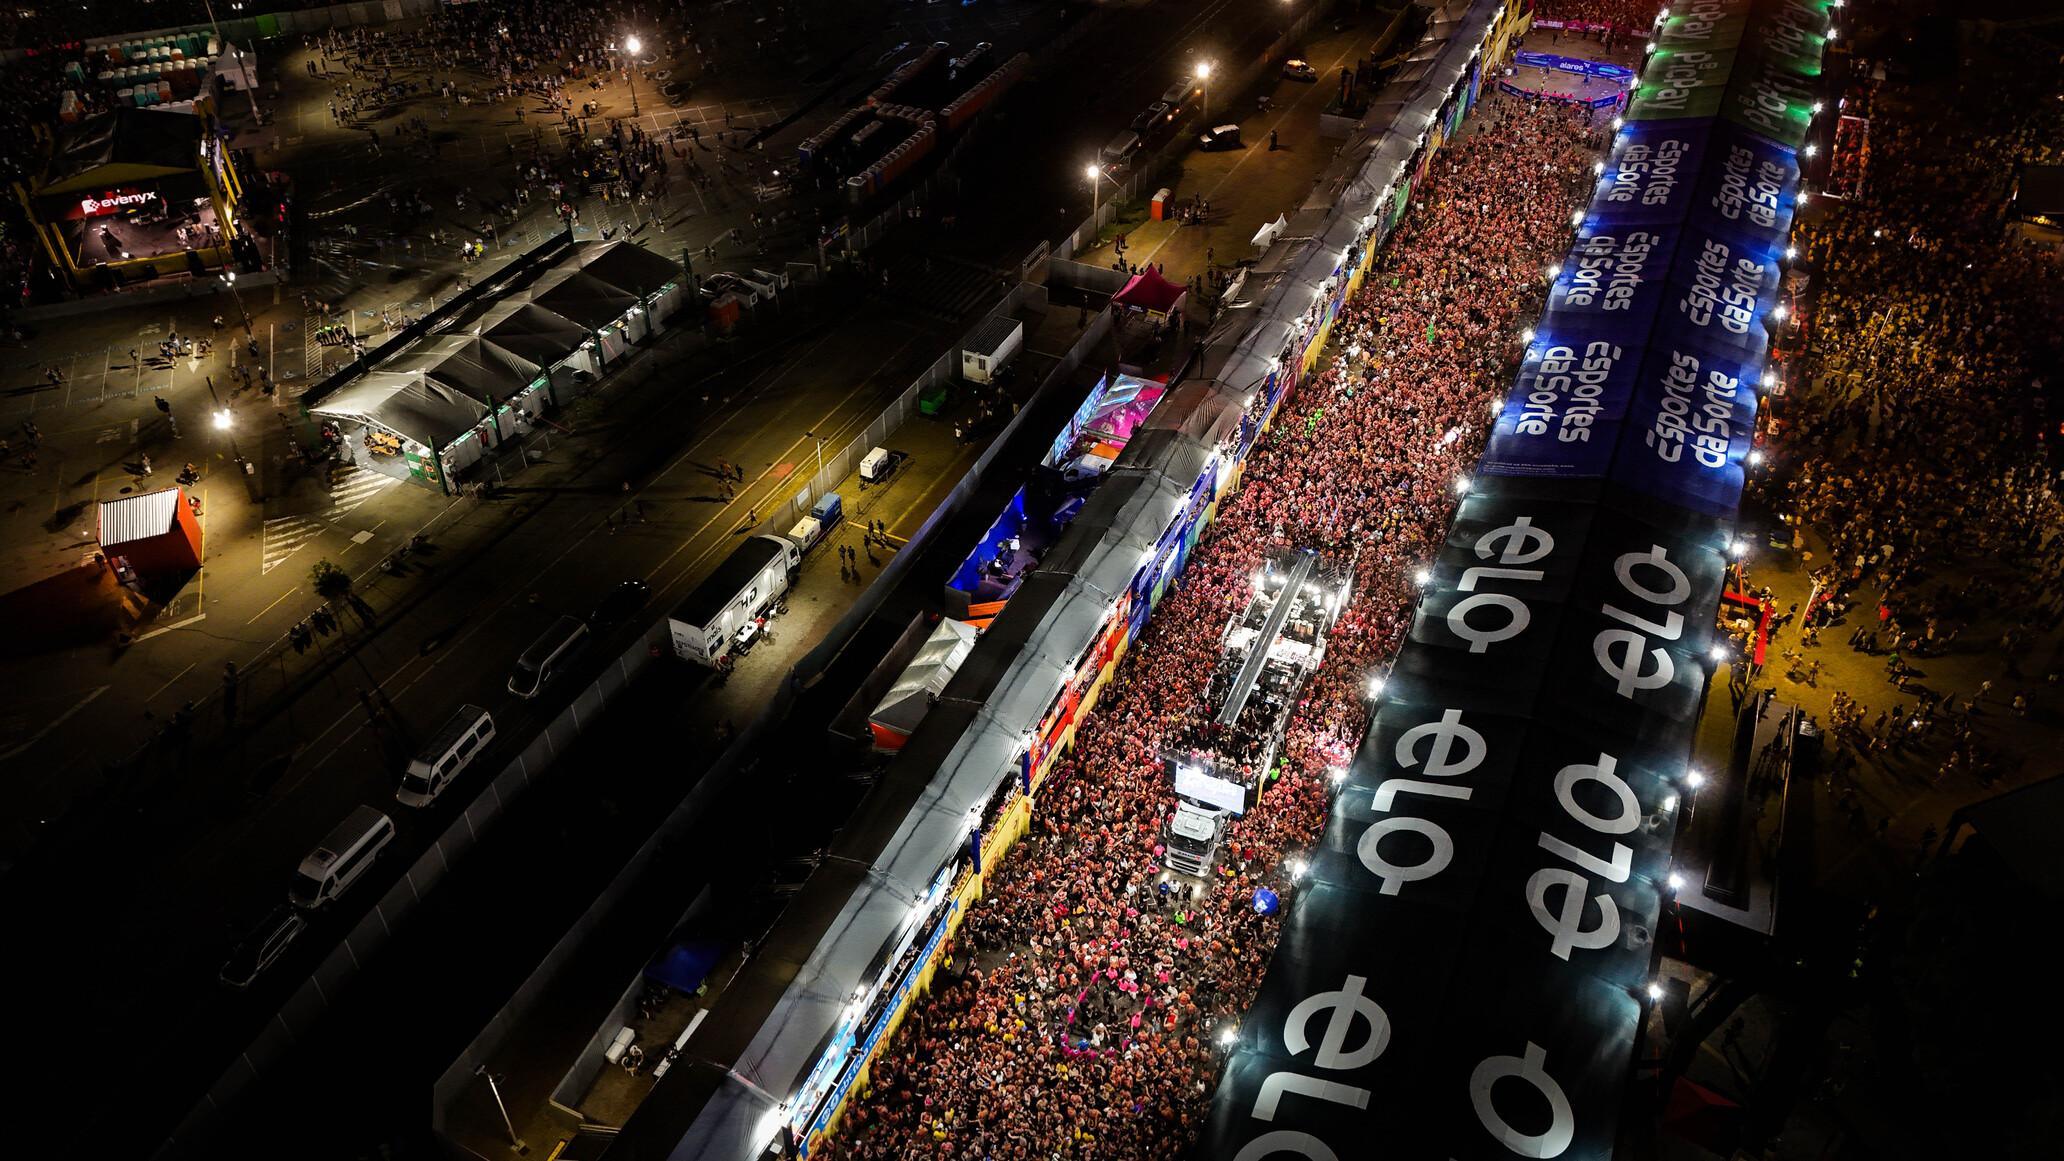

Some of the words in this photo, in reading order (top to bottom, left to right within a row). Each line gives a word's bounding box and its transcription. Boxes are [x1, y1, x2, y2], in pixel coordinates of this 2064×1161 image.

[1663, 0, 1728, 39] icPay
[1643, 51, 1713, 110] PicPay
[101, 191, 157, 207] evenyx
[740, 586, 758, 611] HD
[1447, 516, 1555, 653] elo
[1593, 544, 1692, 699] elo
[1356, 709, 1487, 896] elo
[1525, 752, 1643, 962] elo
